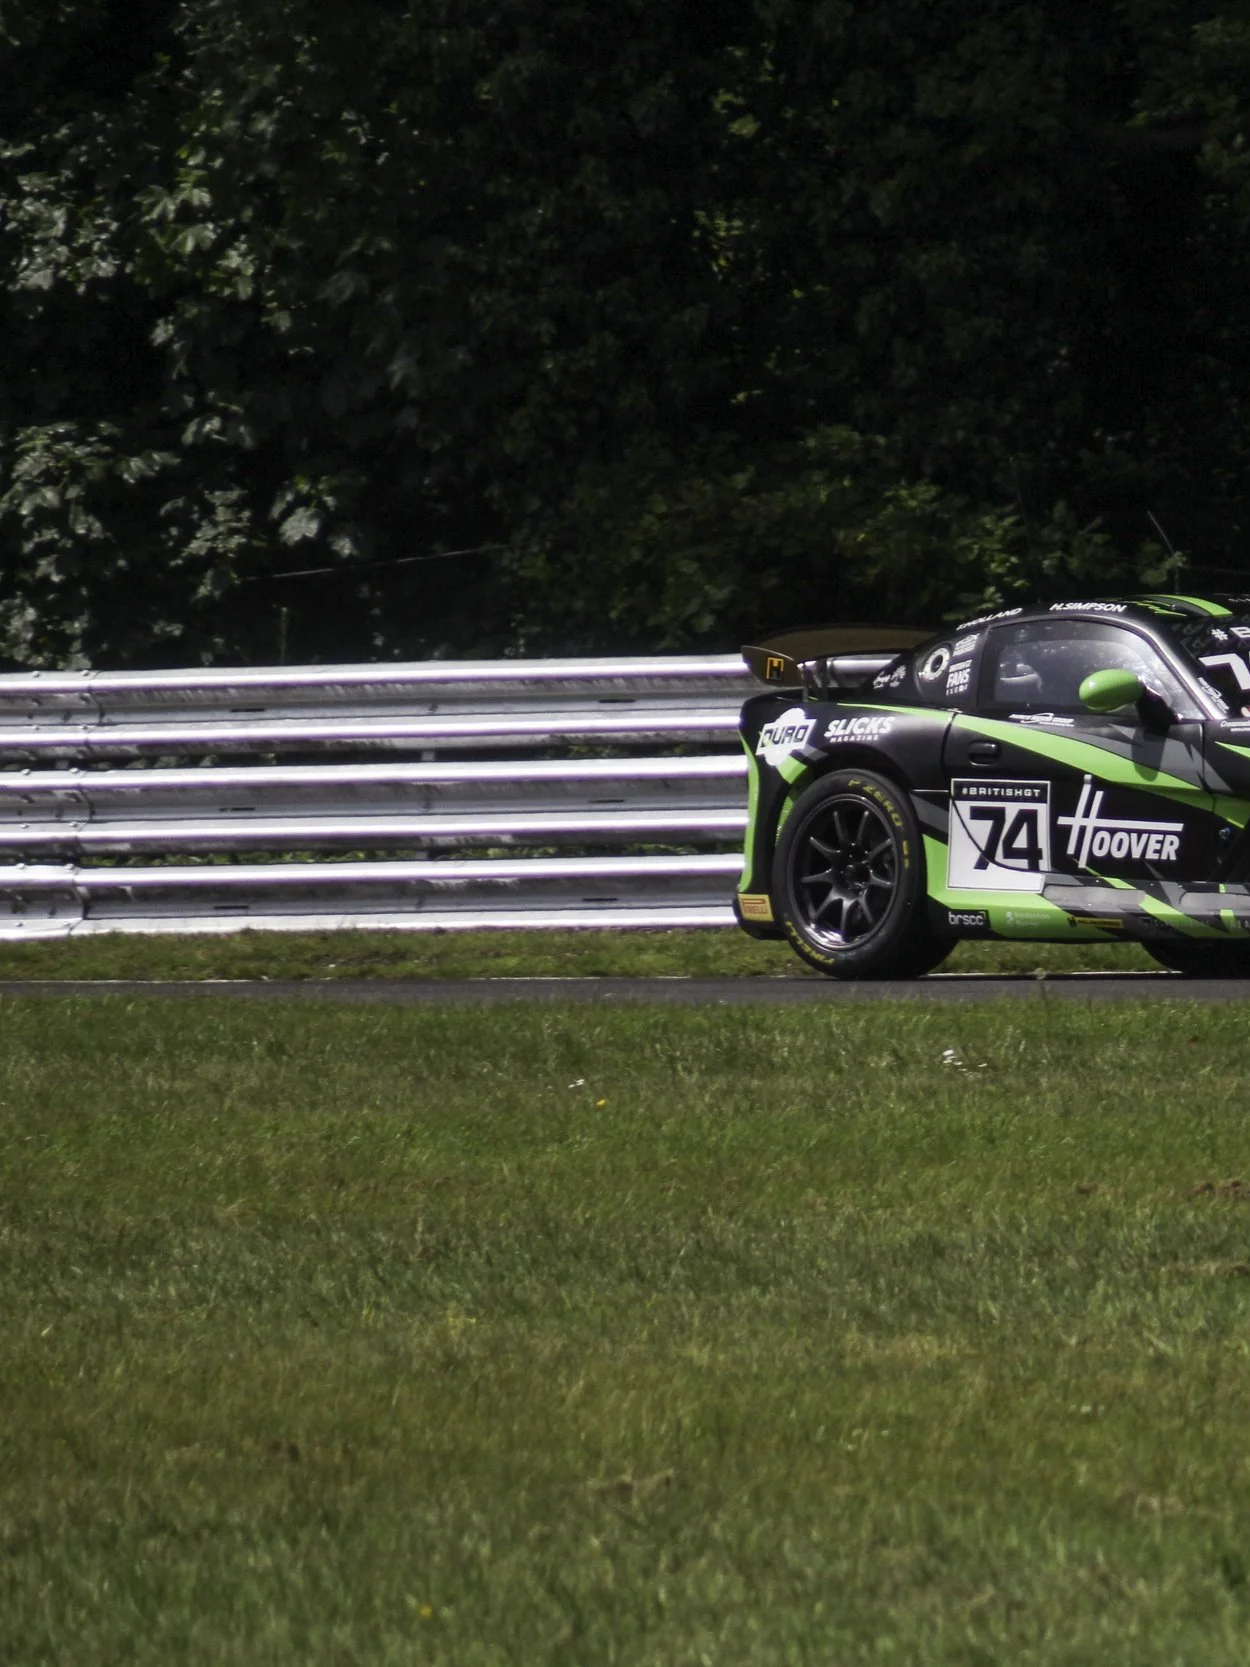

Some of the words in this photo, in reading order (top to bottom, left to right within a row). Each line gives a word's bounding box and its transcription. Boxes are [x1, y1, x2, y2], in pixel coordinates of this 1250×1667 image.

[1049, 602, 1127, 613] H.SIMPSON
[824, 716, 897, 737] SLICKS
[830, 735, 879, 743] MAGAZINE
[962, 787, 1040, 797] #BRITISHGT
[1057, 774, 1184, 868] HOOVER
[969, 805, 1043, 871] 74
[948, 912, 984, 925] brscc
